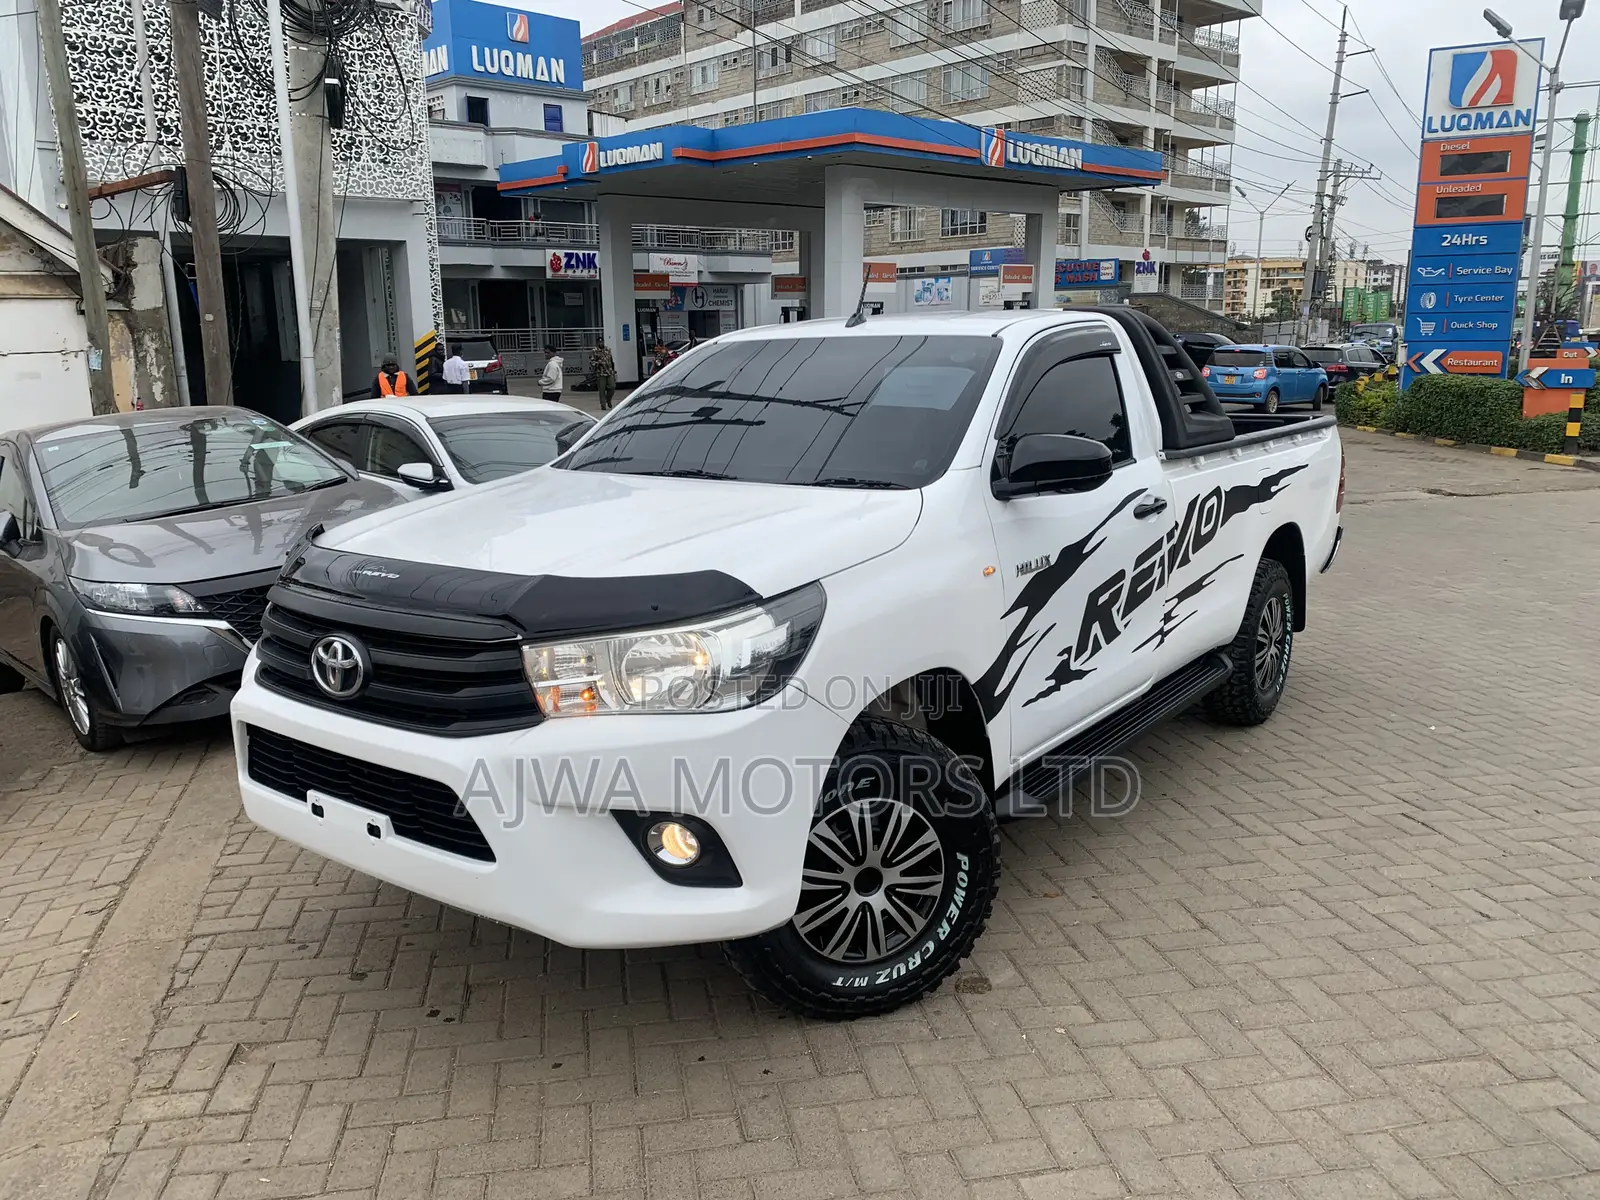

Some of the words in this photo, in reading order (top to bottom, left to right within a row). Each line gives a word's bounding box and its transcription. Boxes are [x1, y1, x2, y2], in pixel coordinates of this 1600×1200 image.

[470, 45, 566, 84] LUQMAN
[1427, 108, 1532, 134] LUQMAN
[1440, 142, 1471, 151] Diesel
[600, 142, 663, 168] LUQMAN
[1006, 140, 1083, 170] LUQMAN
[1436, 184, 1482, 194] Unleaded
[1441, 233, 1488, 247] 24Hrs
[563, 252, 598, 270] ZNK
[1055, 262, 1099, 273] ECUTIVE
[1135, 261, 1157, 274] ZNK
[1456, 266, 1492, 276] Service
[1494, 265, 1513, 276] Bay
[1454, 294, 1473, 304] Tyre
[1475, 293, 1504, 303] Center
[1450, 321, 1474, 329] Quick
[1476, 321, 1498, 330] Shop
[1447, 357, 1498, 367] Restaurant
[1560, 373, 1573, 384] In
[1016, 553, 1052, 578] HILUX
[1071, 485, 1222, 664] REVO
[935, 852, 971, 941] POWER
[875, 940, 936, 986] CRUZ
[832, 975, 870, 988] M/T
